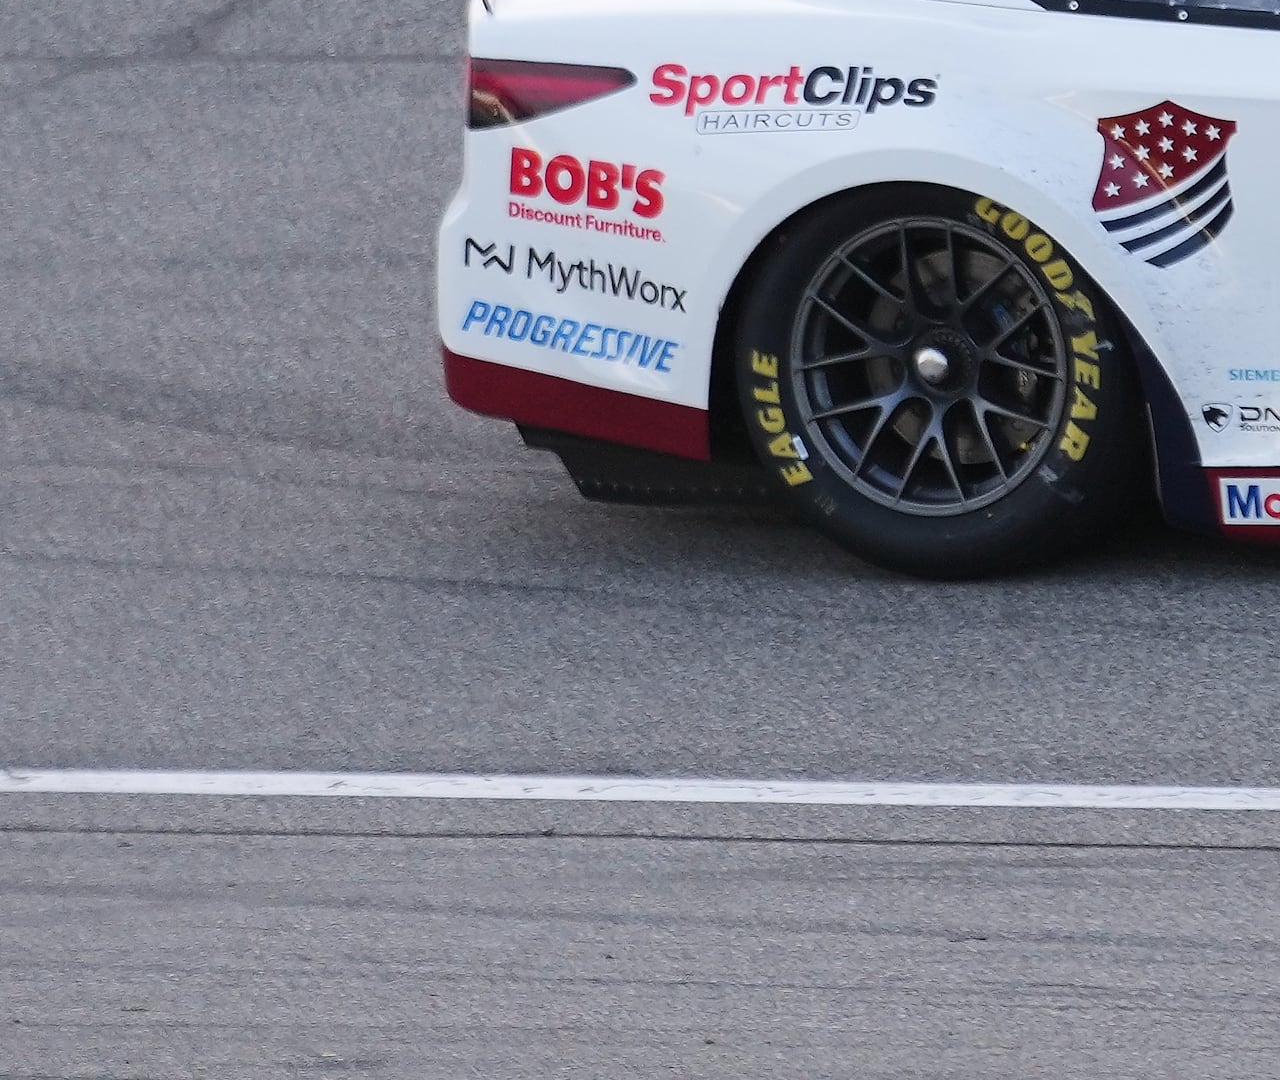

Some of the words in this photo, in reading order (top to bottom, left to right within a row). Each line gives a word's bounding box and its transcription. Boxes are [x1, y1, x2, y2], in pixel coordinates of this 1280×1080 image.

[649, 63, 939, 117] SportClips
[703, 112, 853, 130] HAIRCUTS
[508, 201, 584, 229] Discount
[510, 147, 667, 219] BOB'S
[527, 247, 689, 314] MythWorx
[462, 300, 680, 373] PROGRESSIVE
[973, 196, 1102, 462] GOODYEAR
[752, 350, 813, 487] EAGLE
